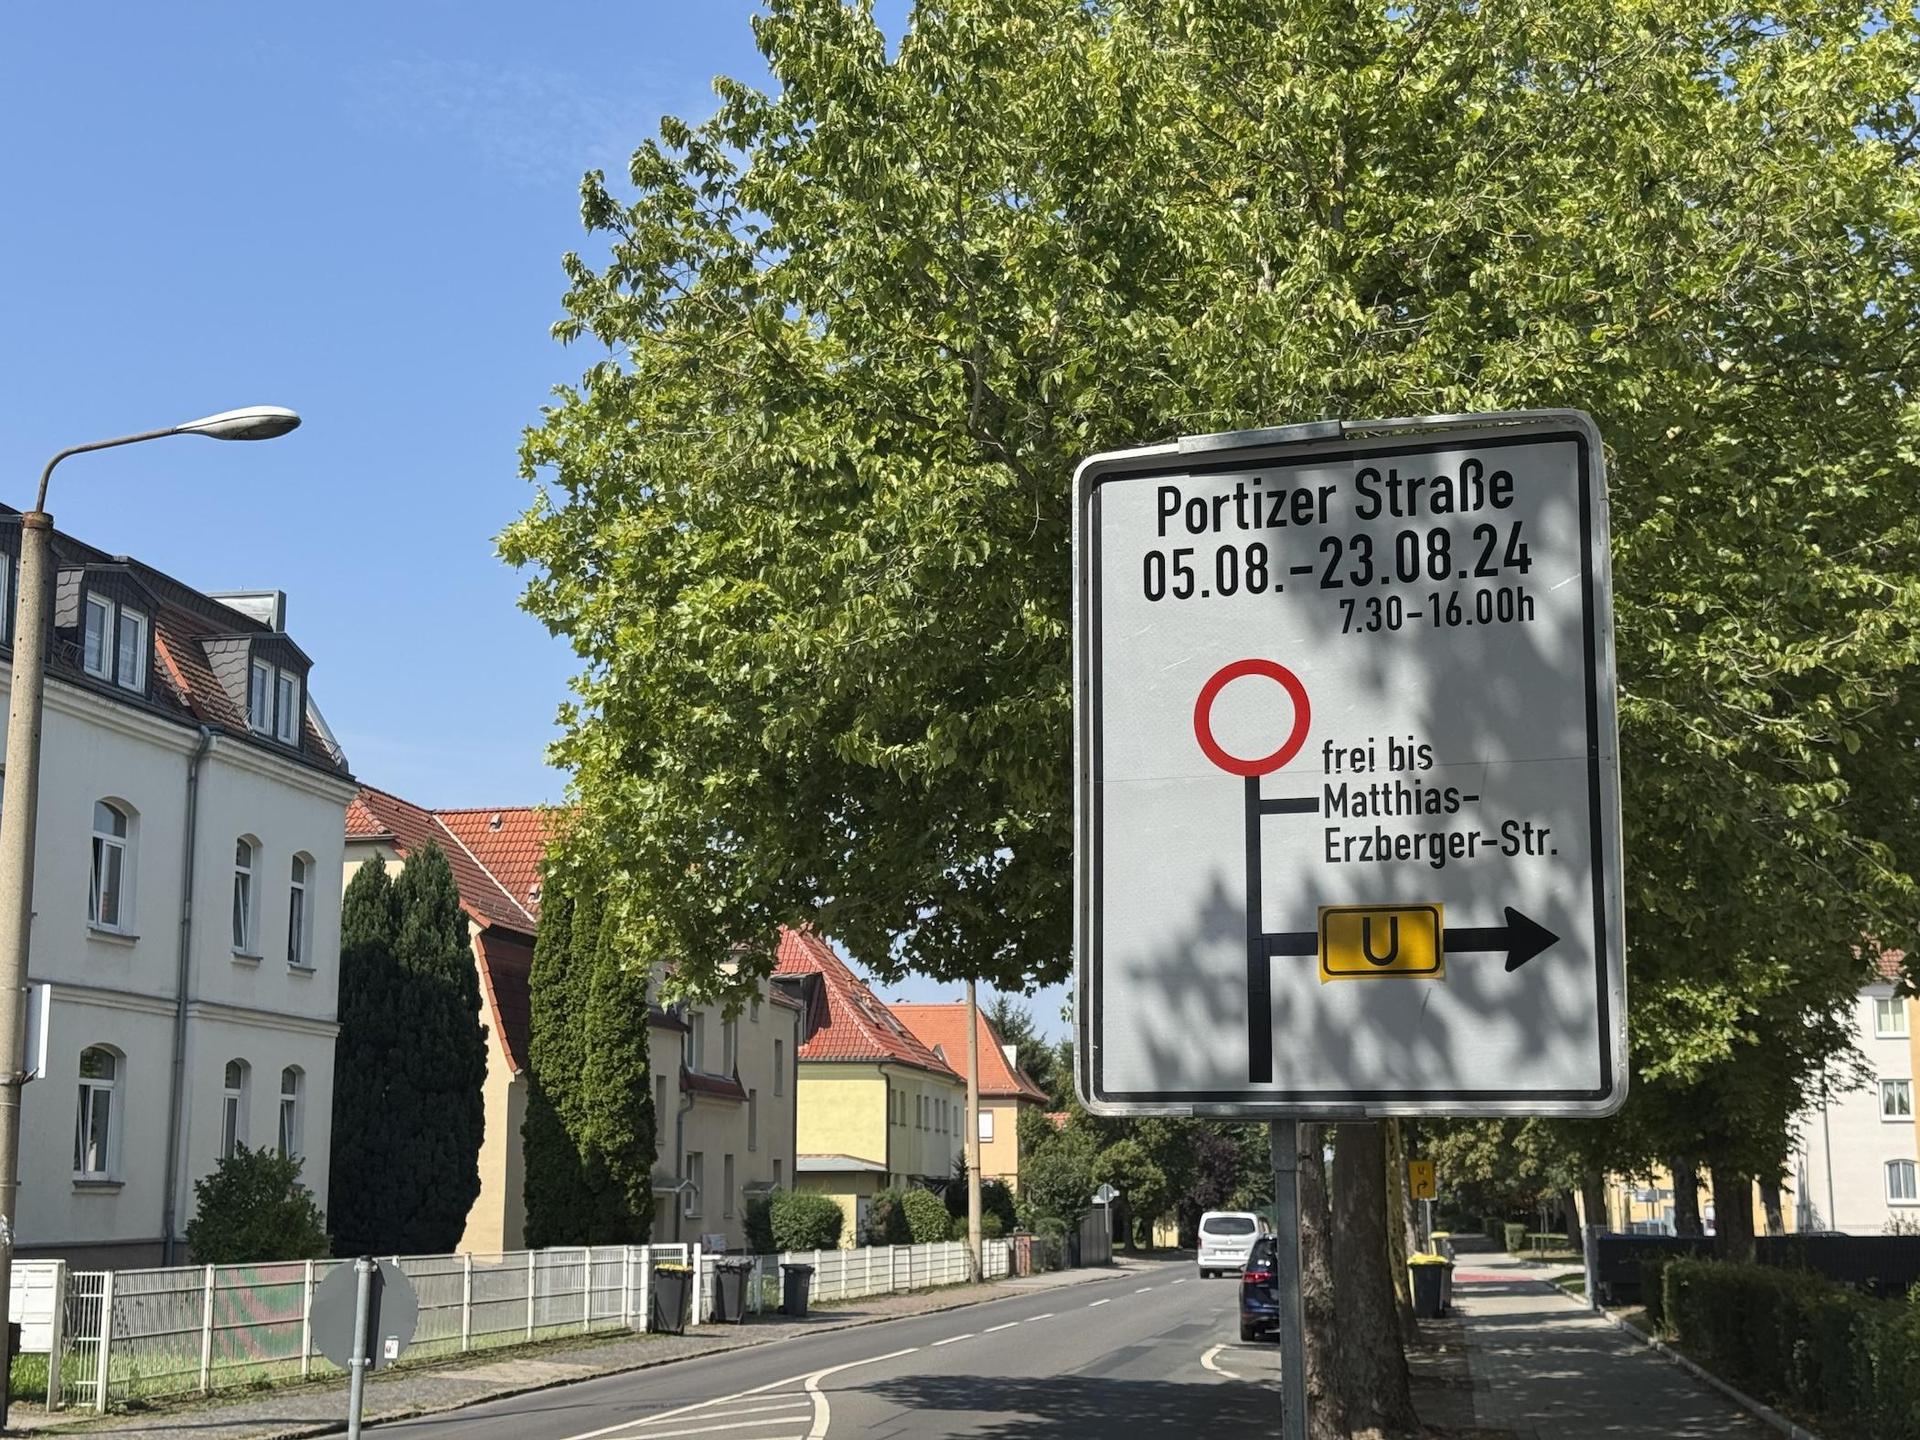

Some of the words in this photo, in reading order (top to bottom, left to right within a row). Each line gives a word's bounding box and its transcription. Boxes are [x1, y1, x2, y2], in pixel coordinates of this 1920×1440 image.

[1158, 478, 1337, 537] Portizer
[1355, 458, 1514, 521] Straße
[1339, 586, 1535, 634] 7.30-16.00h
[1322, 737, 1376, 775] frei
[1388, 735, 1434, 771] bis
[1323, 780, 1480, 819] Matthias-
[1325, 820, 1558, 869] Erzberger-Str.
[1362, 916, 1399, 966] U
